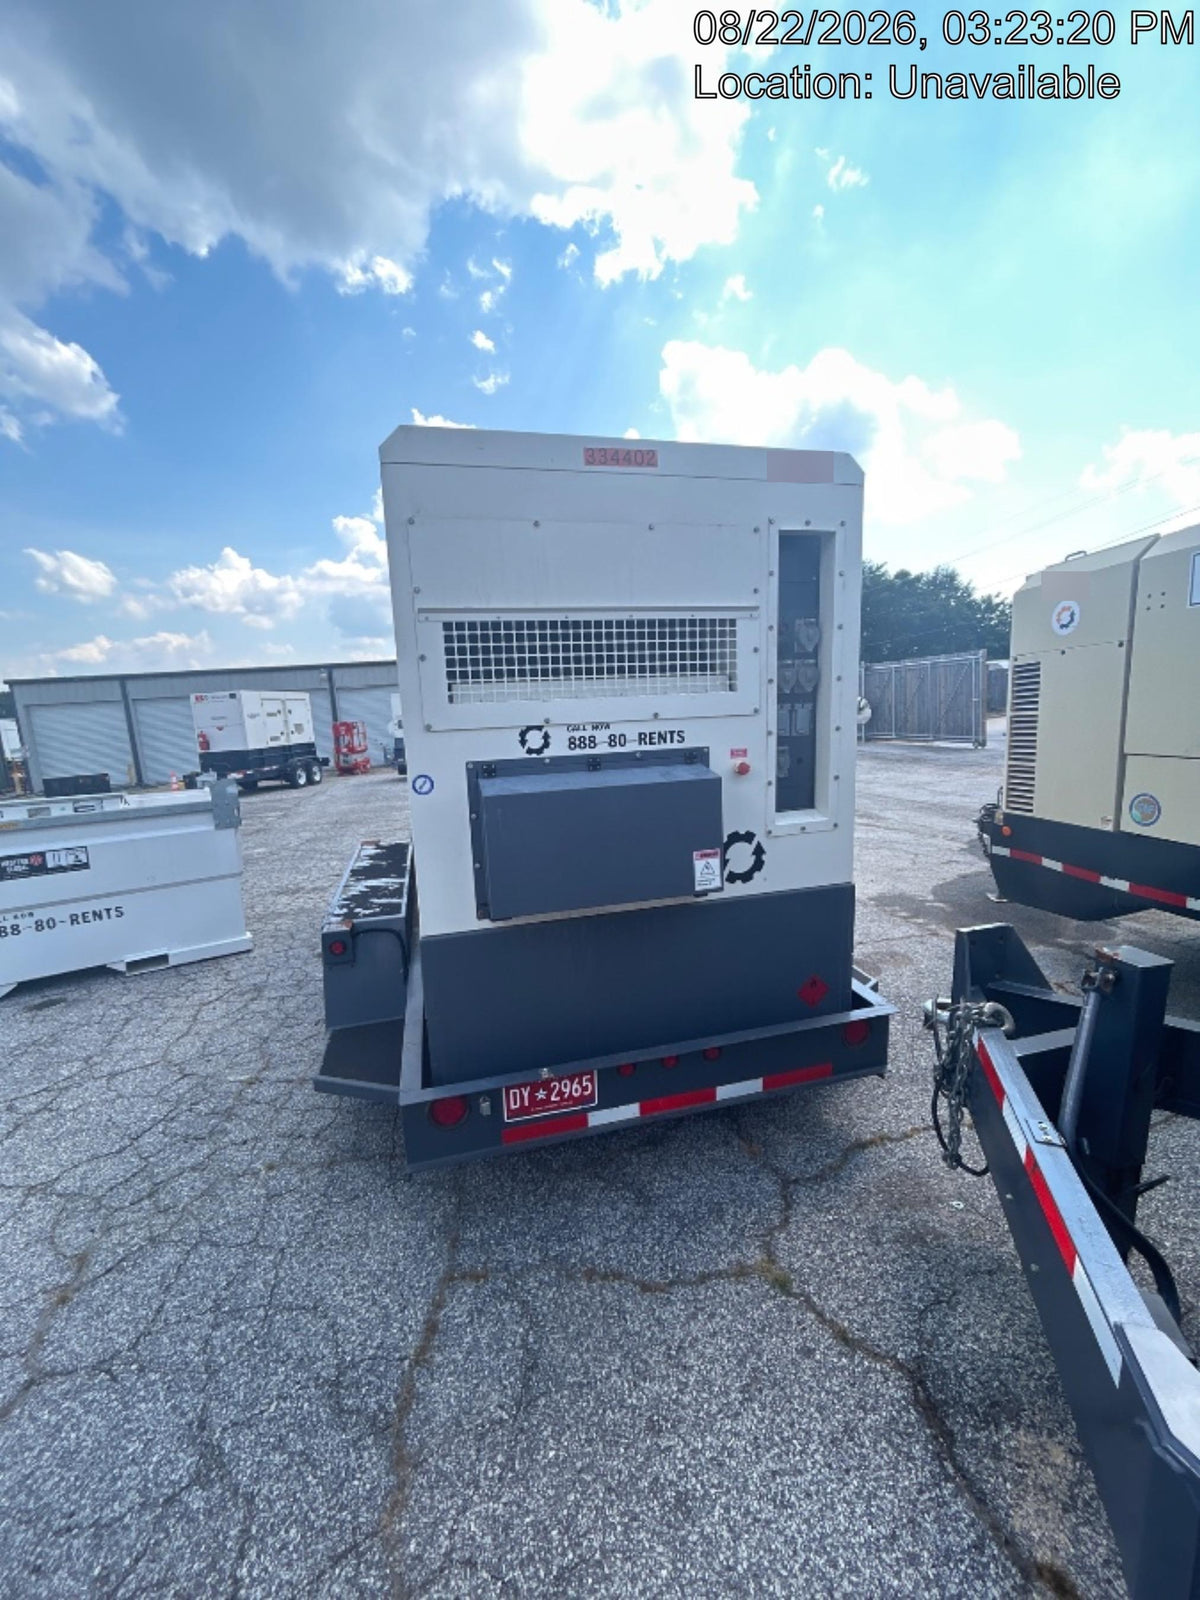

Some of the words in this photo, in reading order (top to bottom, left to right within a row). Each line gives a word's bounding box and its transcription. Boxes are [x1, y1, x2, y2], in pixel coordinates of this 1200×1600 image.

[585, 447, 656, 467] 334402
[509, 1085, 531, 1111] DY
[550, 1074, 593, 1102] 2965
